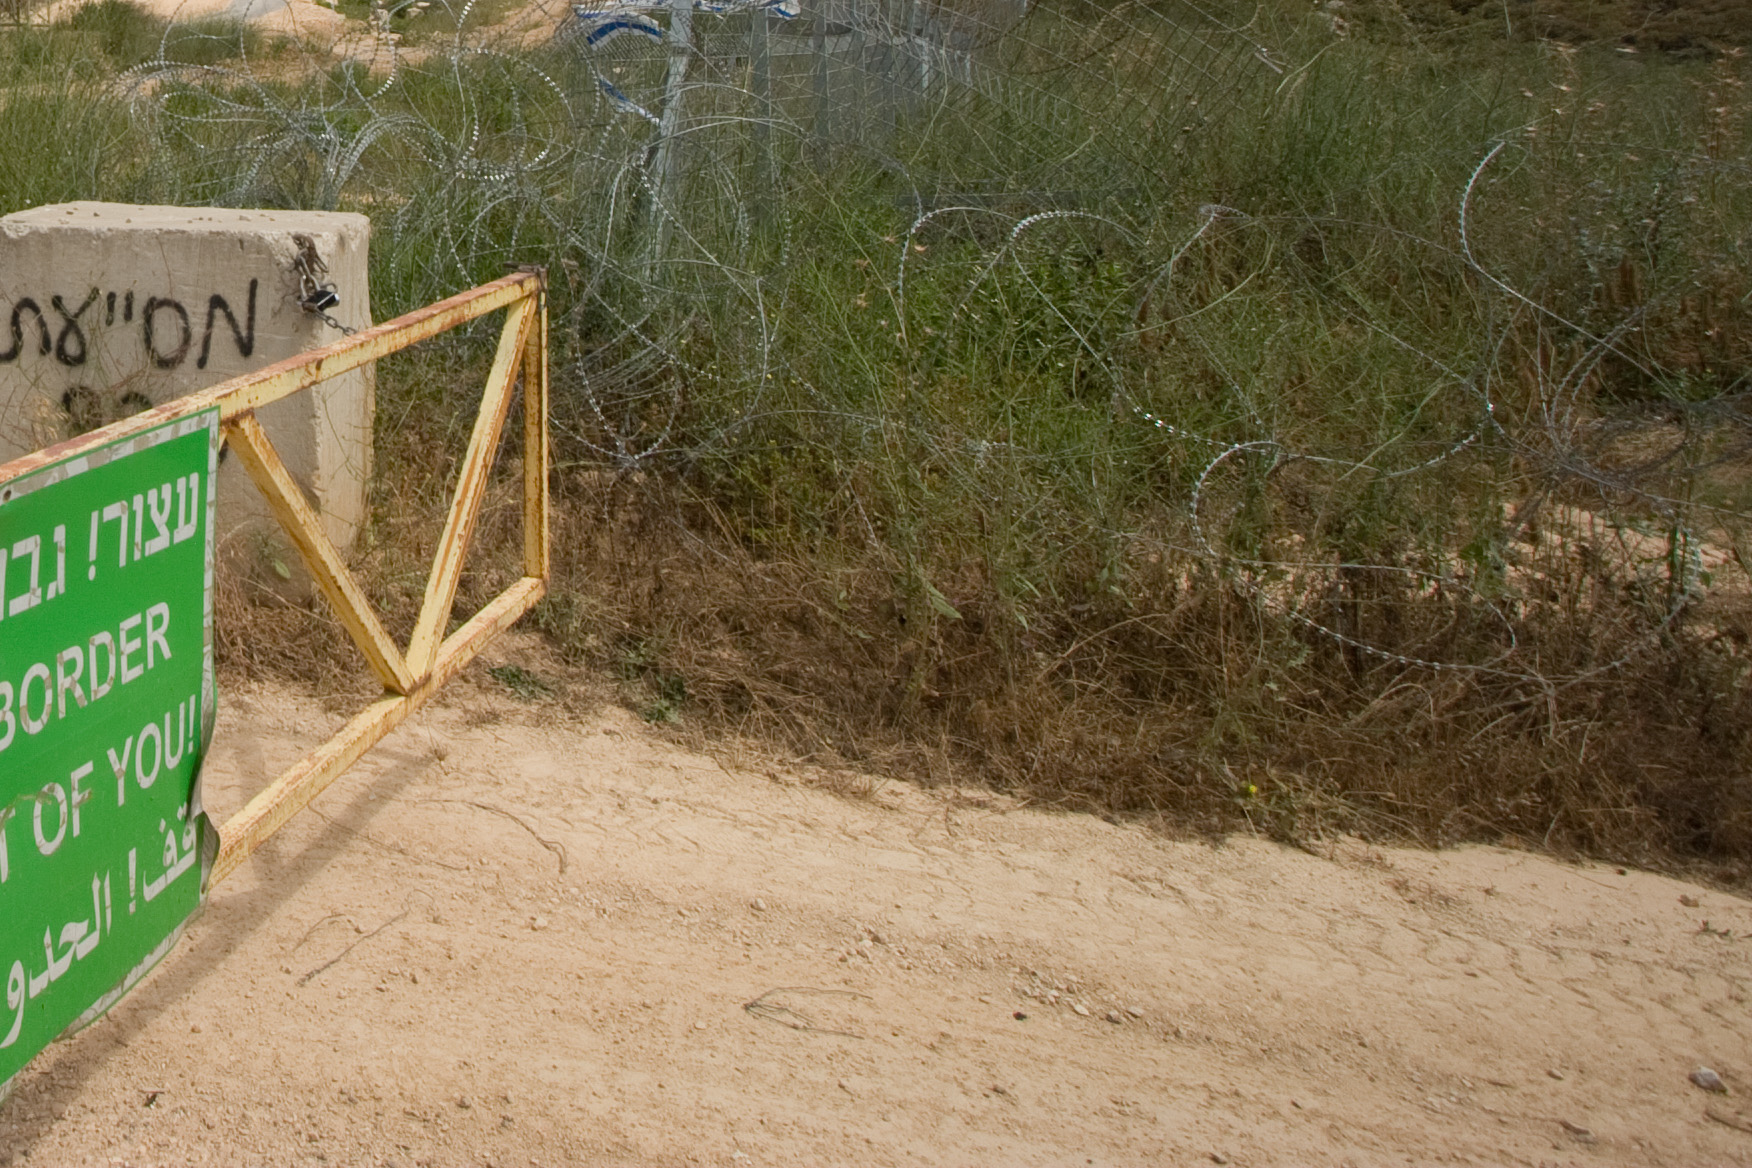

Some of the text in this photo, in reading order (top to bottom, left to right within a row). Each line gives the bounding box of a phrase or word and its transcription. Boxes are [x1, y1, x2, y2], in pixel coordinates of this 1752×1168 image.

[87, 472, 199, 581] עצור!
[33, 760, 94, 856] OF
[106, 694, 197, 807] YOU!
